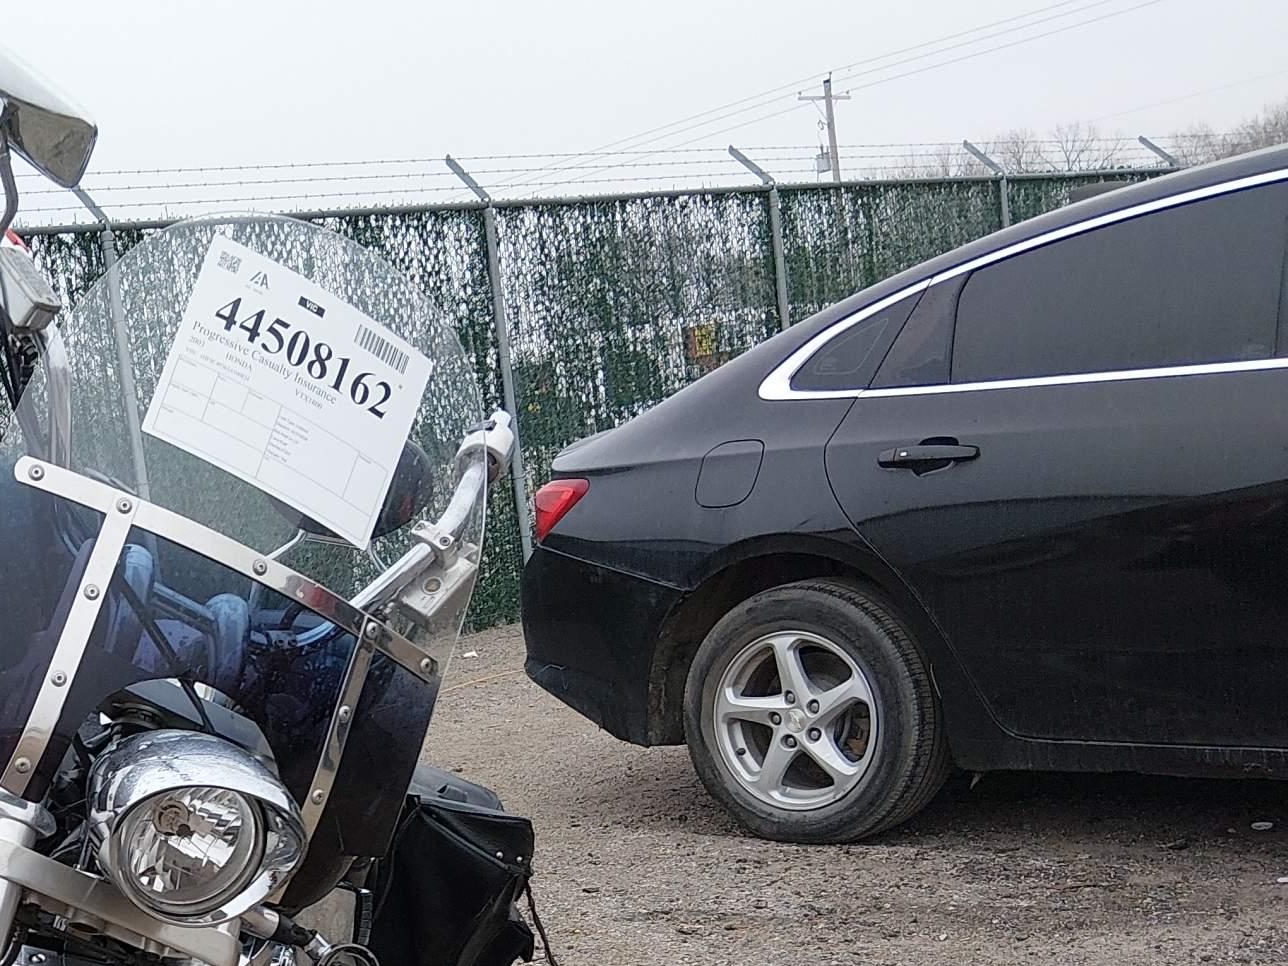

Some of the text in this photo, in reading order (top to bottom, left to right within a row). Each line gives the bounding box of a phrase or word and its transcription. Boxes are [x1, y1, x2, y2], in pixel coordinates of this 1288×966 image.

[303, 299, 319, 313] VIC
[191, 319, 251, 356] Progressive
[249, 348, 292, 381] Casualty
[292, 372, 338, 405] Insurance
[215, 298, 392, 419] 44508162
[224, 351, 252, 372] HONDA
